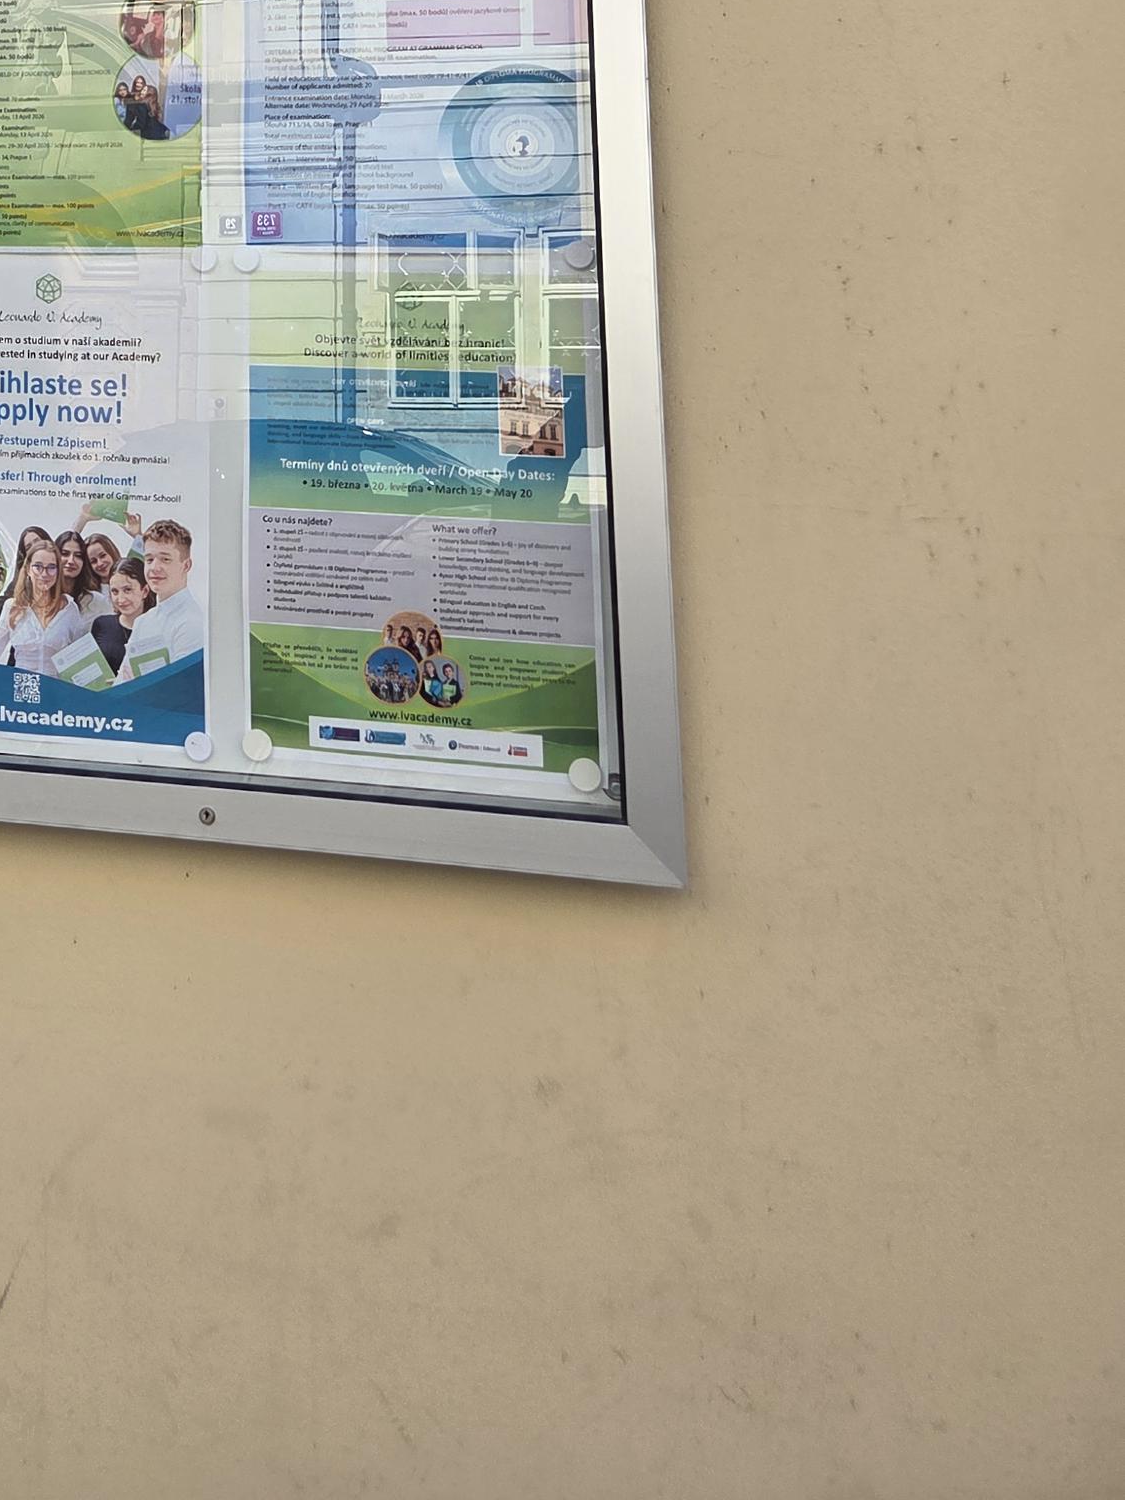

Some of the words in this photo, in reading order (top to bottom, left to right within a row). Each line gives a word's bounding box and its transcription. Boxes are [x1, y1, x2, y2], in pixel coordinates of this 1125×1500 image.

[23, 336, 61, 345] studium
[72, 337, 91, 345] naší
[93, 337, 141, 347] akademii?
[315, 334, 356, 346] Objevte
[27, 350, 35, 359] in
[38, 350, 78, 361] studying
[81, 352, 90, 360] at
[112, 352, 161, 363] Academy?
[304, 348, 348, 358] Discover
[91, 374, 127, 397] se!
[58, 401, 121, 424] now!
[57, 436, 107, 449] Zápisem!
[51, 452, 80, 460] zkoušek
[102, 454, 130, 462] ročníku
[280, 458, 324, 473] Termíny
[327, 460, 348, 470] dnů
[351, 462, 413, 476] otevřených
[417, 464, 446, 476] dveří
[518, 469, 555, 480] Dates:
[27, 471, 72, 485] Through
[75, 474, 136, 486] enrolment!
[72, 490, 86, 498] first
[88, 492, 104, 500] year
[311, 479, 325, 488] 19.
[328, 479, 360, 489] března
[390, 482, 423, 493] května
[435, 485, 467, 495] March
[471, 487, 482, 496] 19
[494, 488, 517, 499] May
[520, 489, 532, 498] 20
[262, 515, 273, 523] Co
[282, 516, 296, 524] nás
[298, 517, 333, 527] najdete?
[432, 524, 455, 534] What
[472, 526, 497, 535] offer?
[369, 710, 472, 726] www.lvacademy.cz
